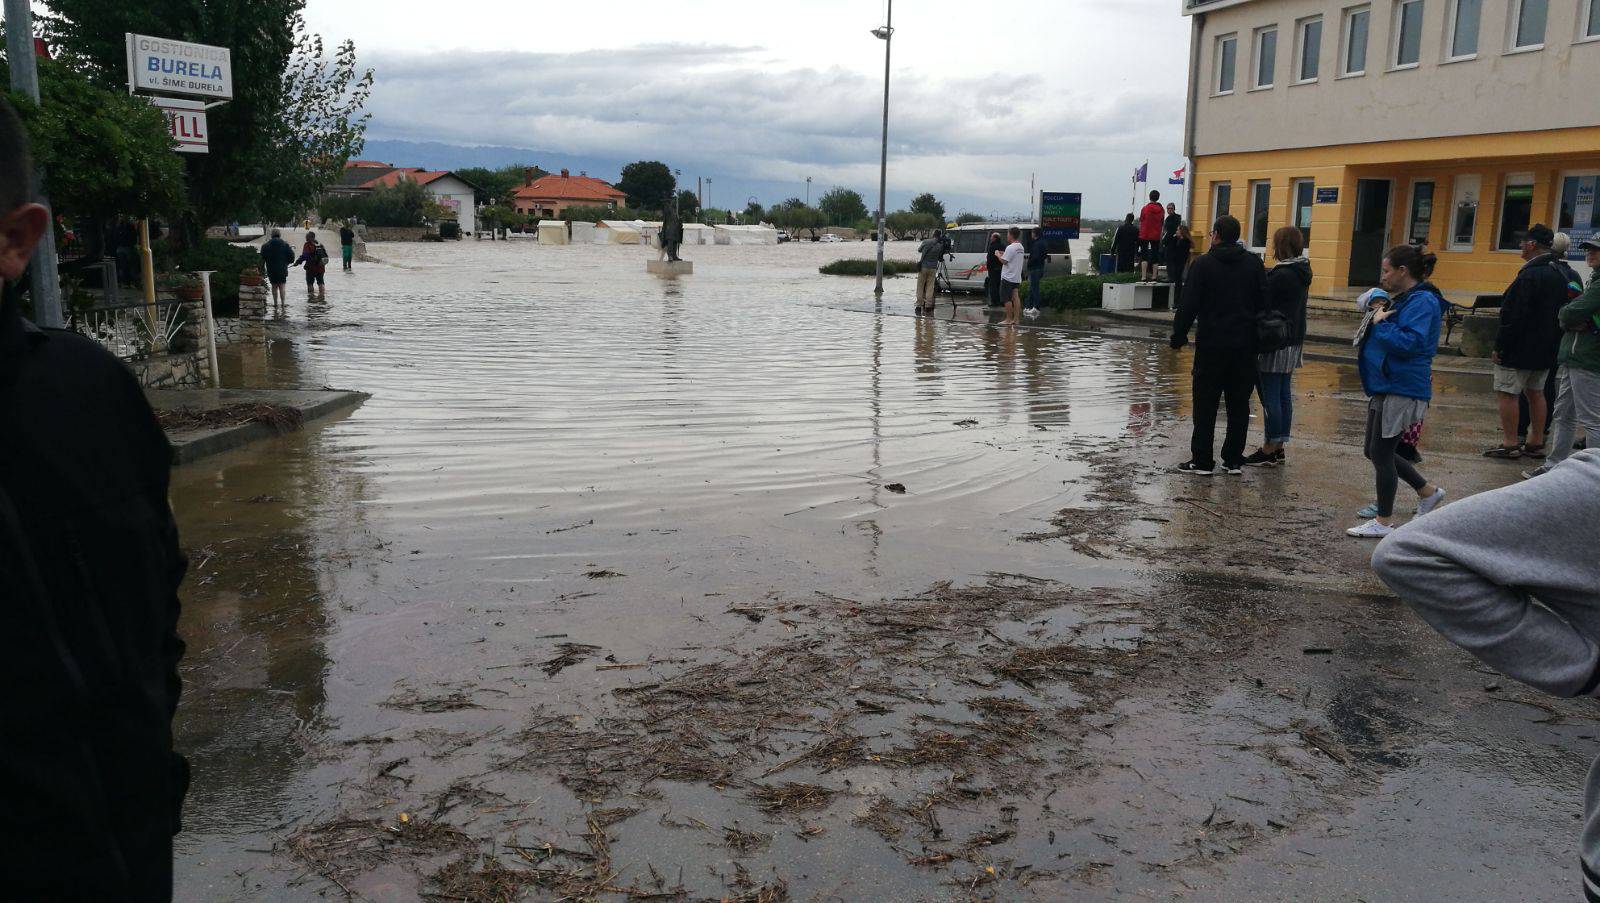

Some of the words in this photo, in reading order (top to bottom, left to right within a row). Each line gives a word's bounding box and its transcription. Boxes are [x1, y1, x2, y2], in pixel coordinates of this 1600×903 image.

[140, 39, 227, 62] GOSTIONICA
[148, 56, 222, 80] BURELA
[188, 81, 223, 92] BURELA
[171, 115, 203, 138] ILL
